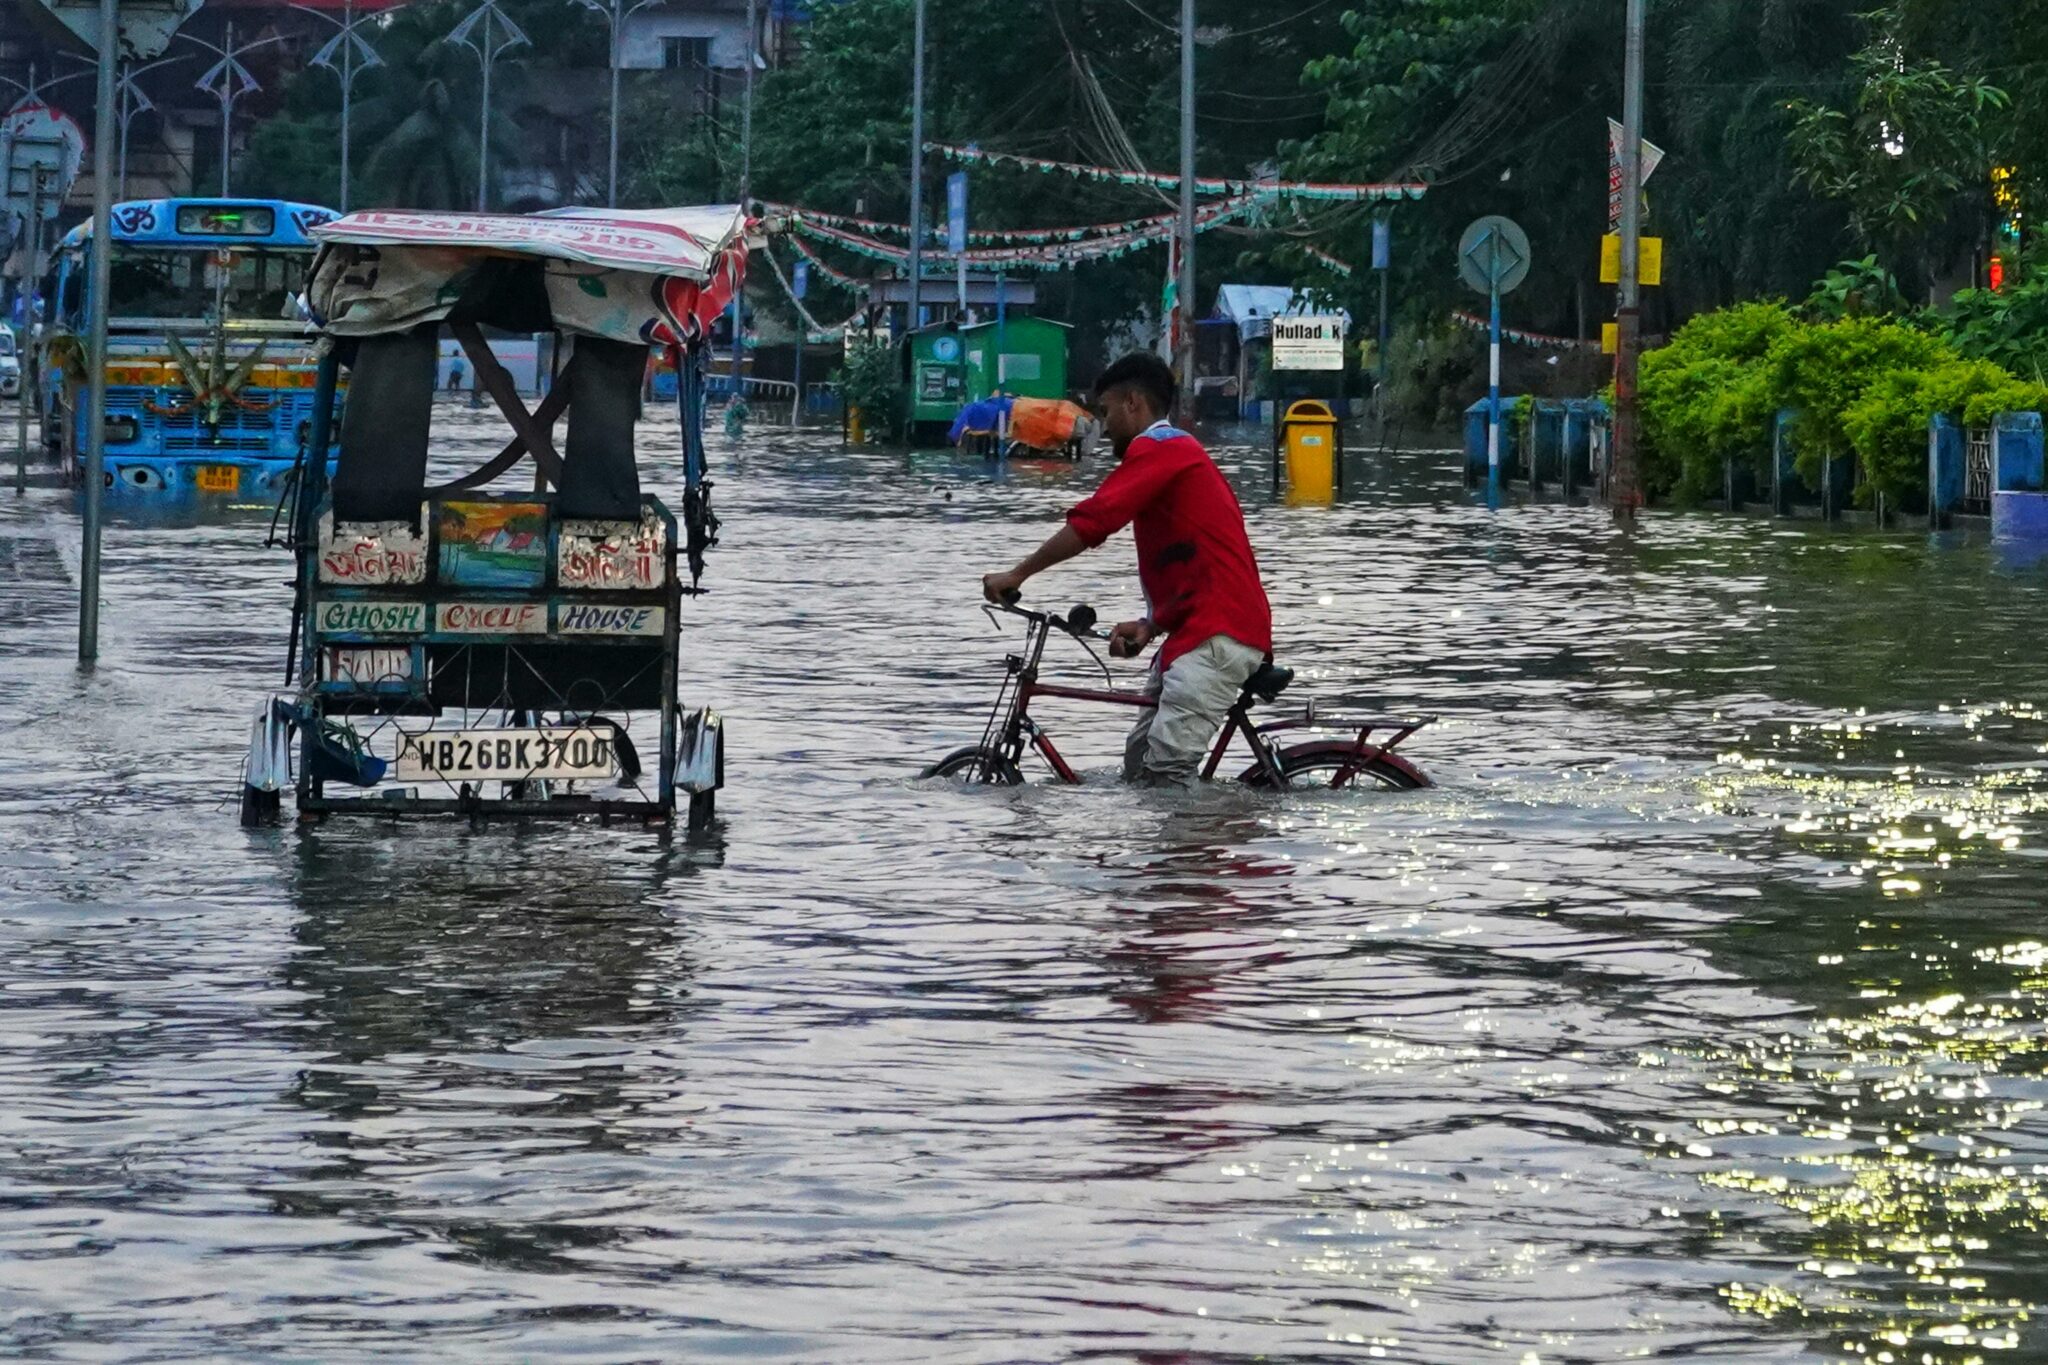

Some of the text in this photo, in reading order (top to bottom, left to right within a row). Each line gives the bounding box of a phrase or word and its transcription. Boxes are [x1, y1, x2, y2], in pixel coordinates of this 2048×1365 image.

[324, 602, 421, 631] GHOSH
[562, 605, 652, 632] HOUSE
[419, 738, 607, 772] WB26BK3700
